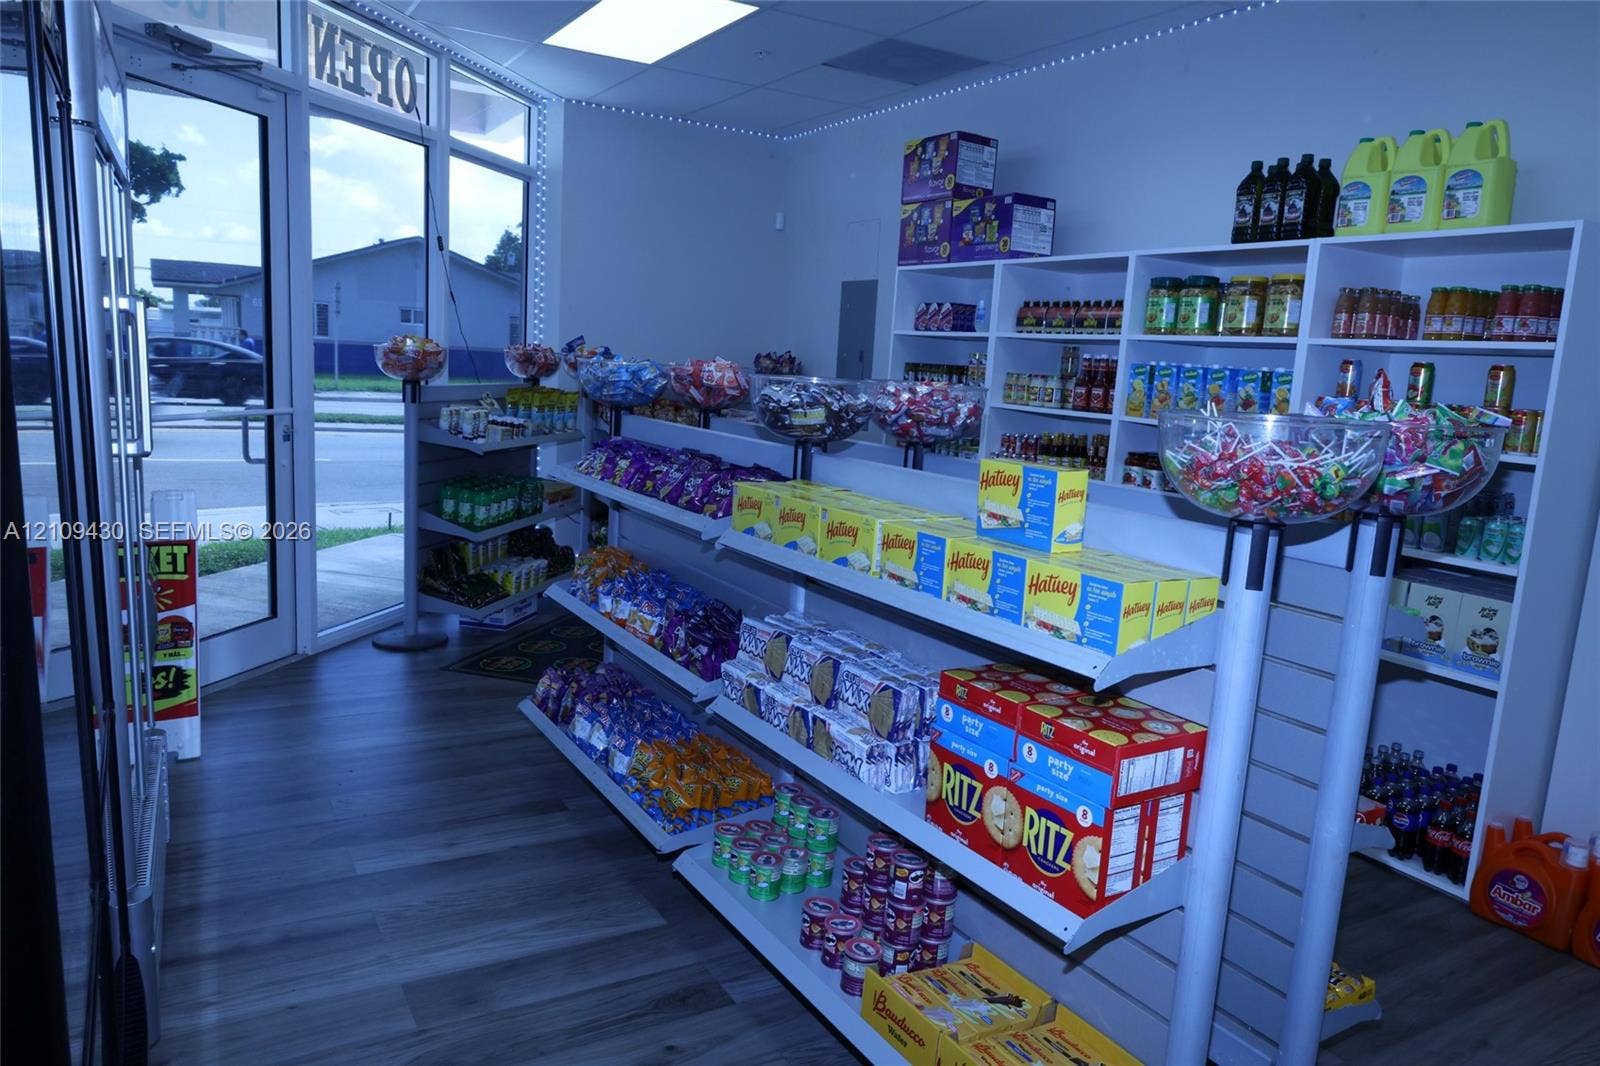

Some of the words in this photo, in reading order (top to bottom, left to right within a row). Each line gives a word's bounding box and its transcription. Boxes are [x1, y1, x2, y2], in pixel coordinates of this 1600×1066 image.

[980, 470, 1020, 497] Hatuey
[737, 496, 762, 519] Hatuey
[1058, 489, 1085, 503] Hatuey
[778, 507, 806, 532] Hatuey
[826, 520, 860, 547] Hatuey
[882, 532, 916, 560] Hatuey
[949, 551, 991, 581] Hatuey
[1028, 573, 1079, 607] Hatuey
[1123, 600, 1151, 619] Hatuey
[1156, 599, 1184, 617] Hatuey
[1189, 597, 1216, 612] Hatuey
[839, 680, 870, 715] MAX
[962, 714, 984, 731] party
[1040, 721, 1055, 739] RITZ
[951, 741, 966, 755] party
[1073, 743, 1097, 758] original
[1047, 755, 1074, 775] party
[1051, 766, 1070, 782] size
[941, 761, 984, 820] RITZ
[1036, 784, 1055, 798] party
[1055, 790, 1069, 804] size
[1022, 805, 1075, 872] RITZ
[1490, 884, 1542, 916] Ambar
[872, 990, 927, 1048] Bauducco
